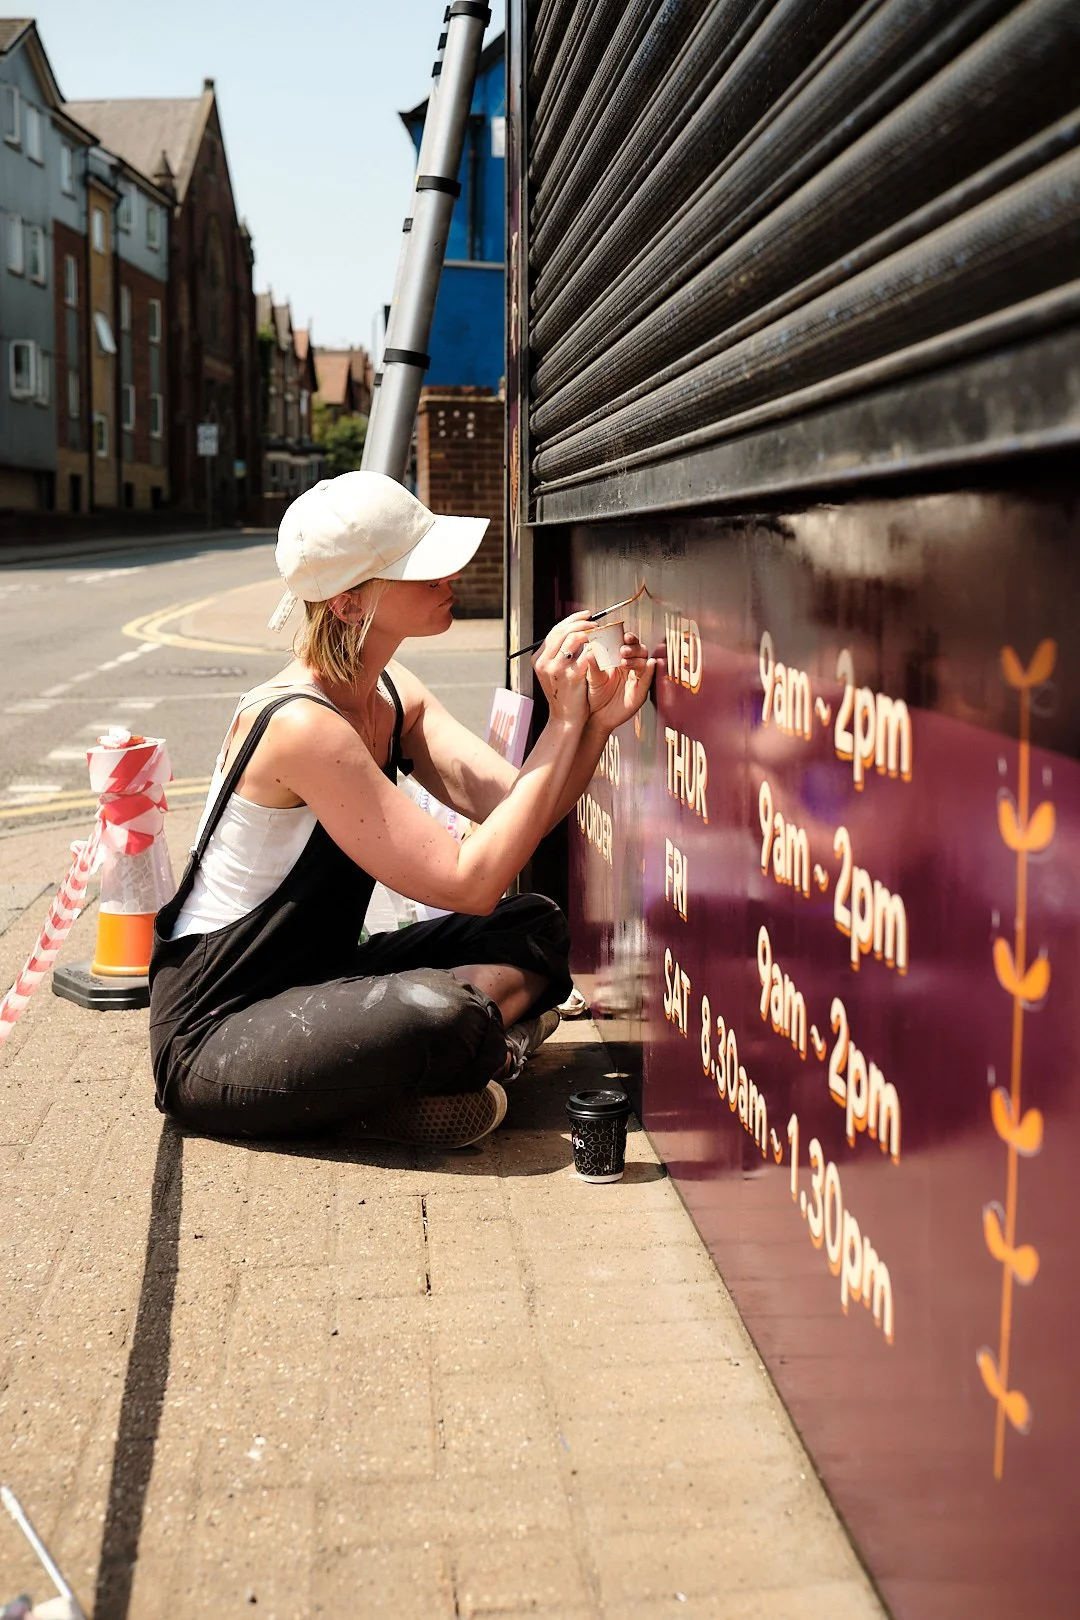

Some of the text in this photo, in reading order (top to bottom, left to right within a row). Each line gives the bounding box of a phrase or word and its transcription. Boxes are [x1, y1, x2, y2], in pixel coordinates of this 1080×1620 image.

[665, 612, 703, 694] WED
[759, 630, 812, 741] 9am
[834, 648, 913, 792] 2pm
[586, 793, 613, 869] ORDER
[665, 726, 709, 824] THUR
[758, 781, 811, 898] 9am
[833, 826, 907, 976] 2pm
[665, 837, 688, 923] FRI
[757, 925, 807, 1060] 9am
[828, 997, 901, 1165] 2pm
[664, 948, 691, 1038] SAT
[701, 995, 767, 1159] 8.30am
[787, 1113, 895, 1345] 1.30pm
